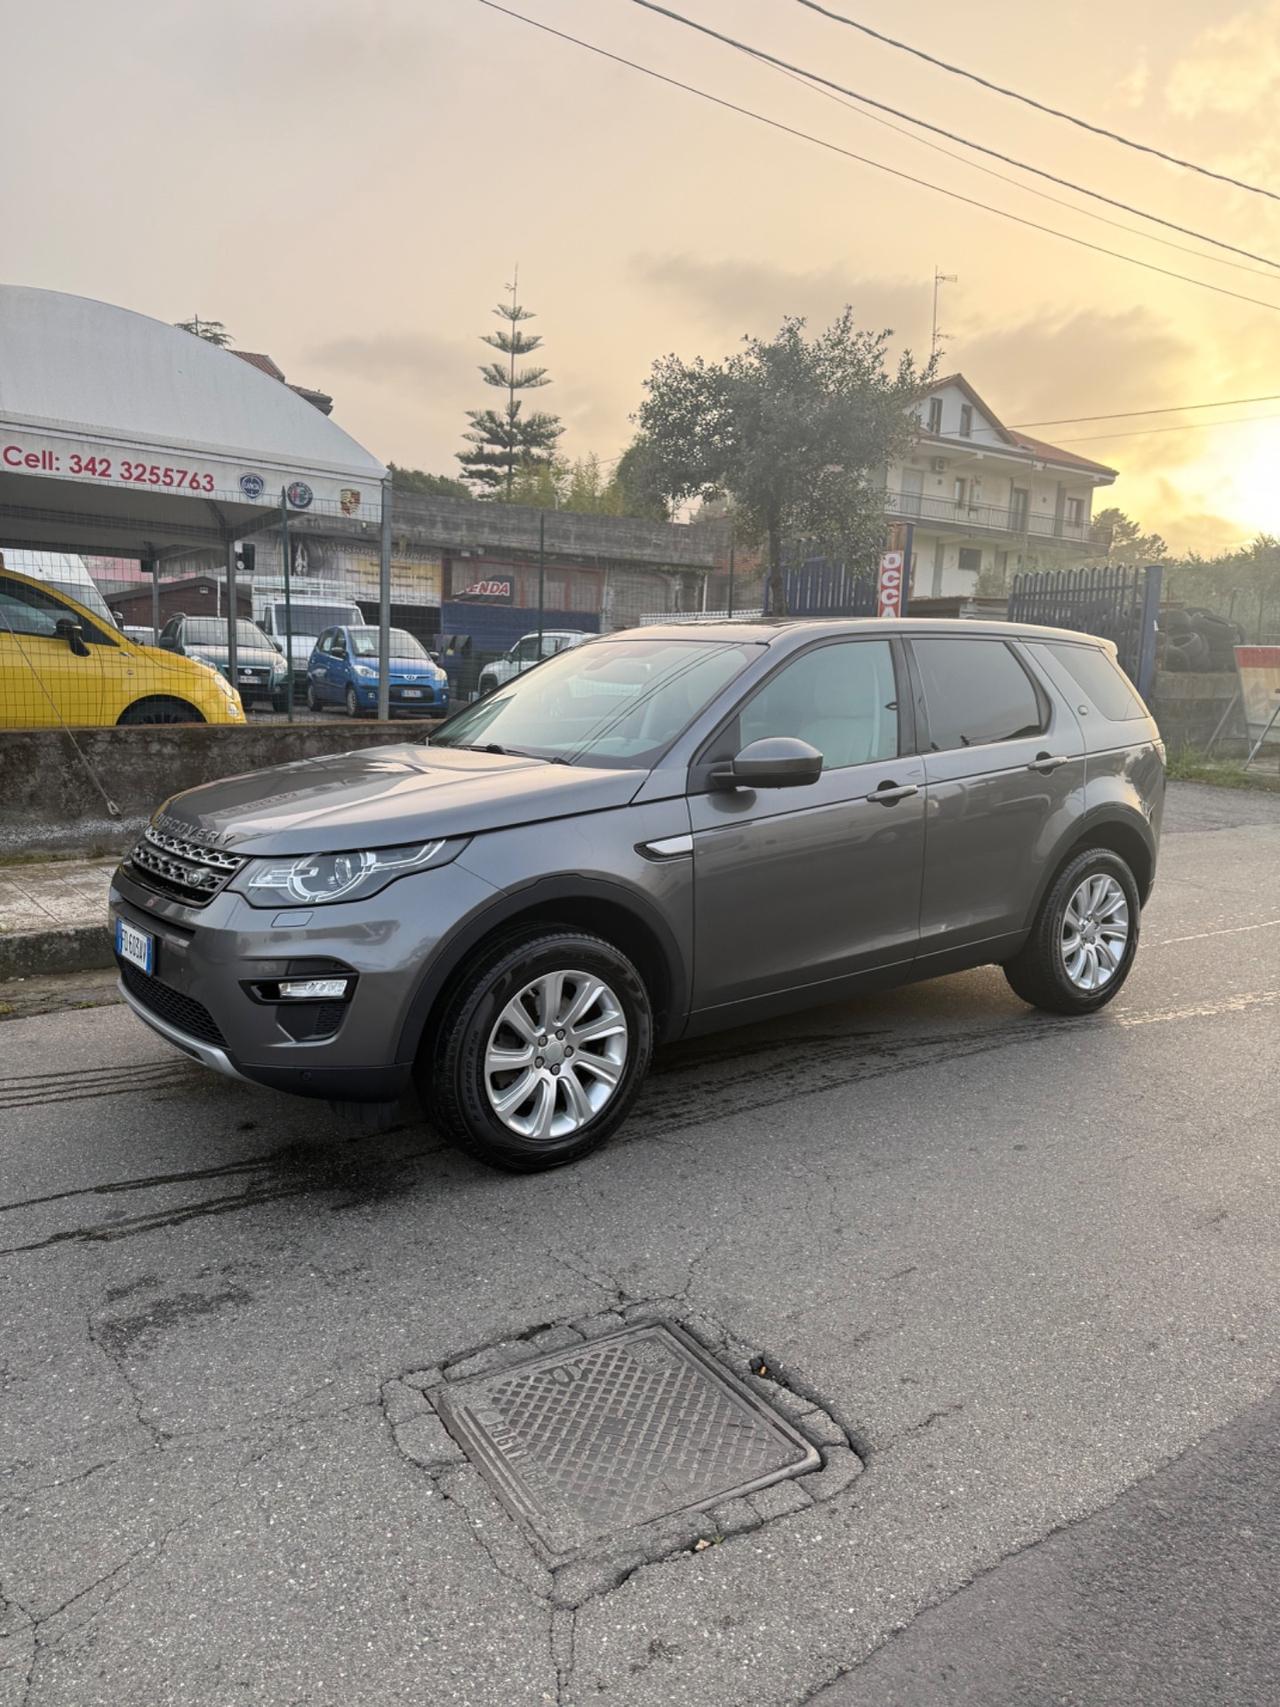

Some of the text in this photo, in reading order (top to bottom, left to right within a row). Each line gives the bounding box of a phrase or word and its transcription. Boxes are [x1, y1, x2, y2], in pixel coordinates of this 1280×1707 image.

[2, 446, 61, 474] Cell:
[69, 454, 112, 478] 342
[119, 461, 215, 493] 3255763
[156, 814, 236, 845] DISCOVERY
